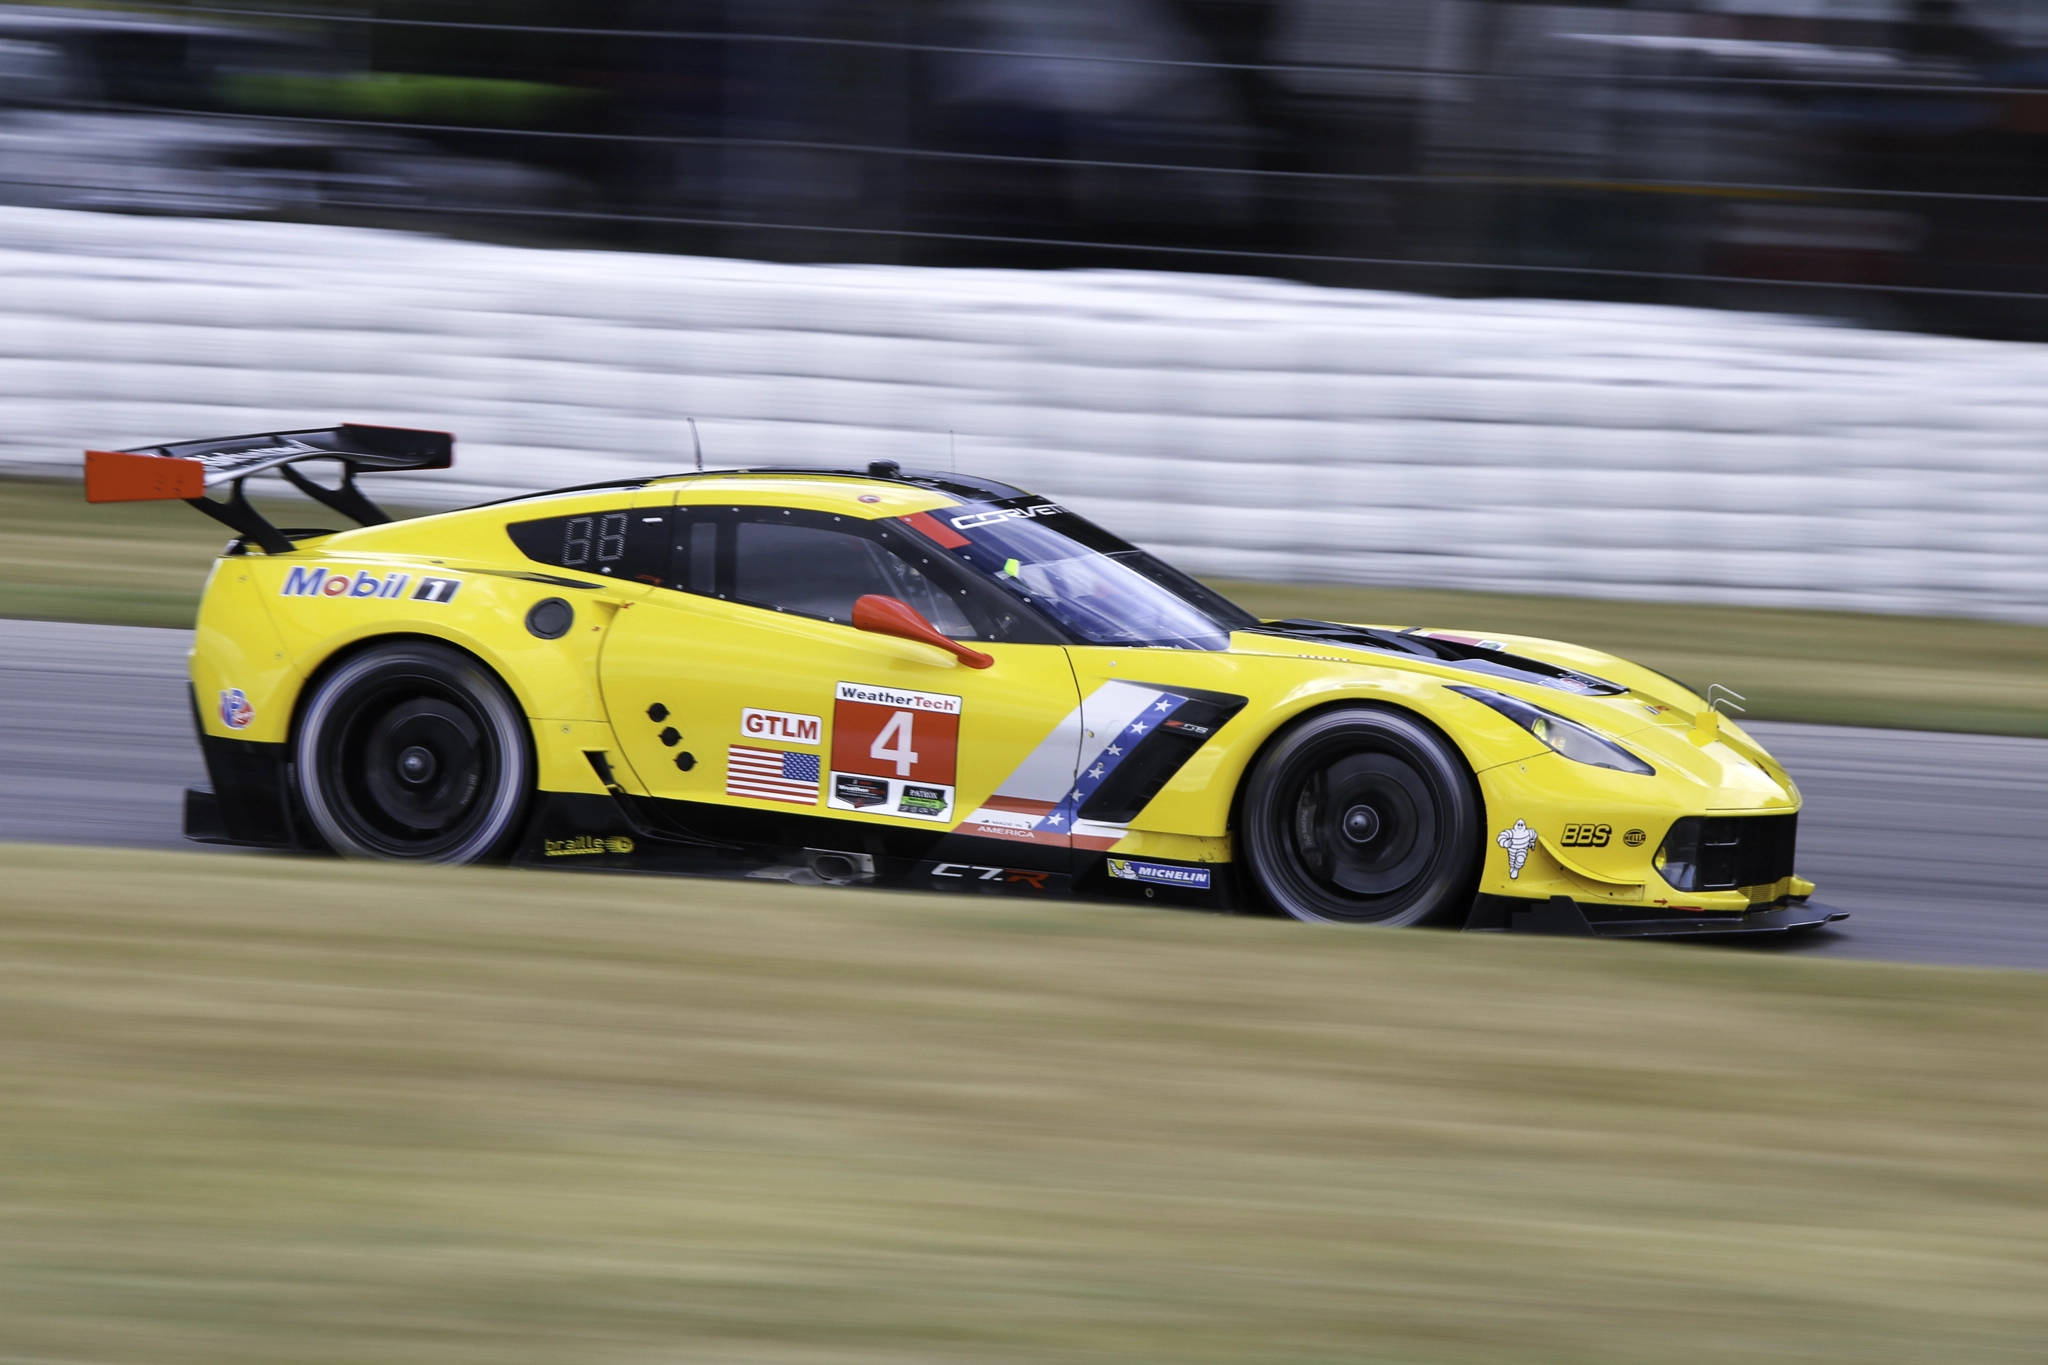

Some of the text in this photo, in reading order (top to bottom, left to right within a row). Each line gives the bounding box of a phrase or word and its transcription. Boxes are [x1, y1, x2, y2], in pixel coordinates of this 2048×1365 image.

[950, 503, 1069, 530] CORVET
[282, 566, 447, 601] Mobil 1
[841, 686, 955, 711] WeatherTech
[746, 713, 818, 740] GTLM
[869, 710, 918, 777] 4
[544, 836, 604, 851] braille
[977, 825, 1035, 839] AMERICA
[1561, 823, 1612, 847] BBS
[1138, 866, 1208, 883] MICHELIN
